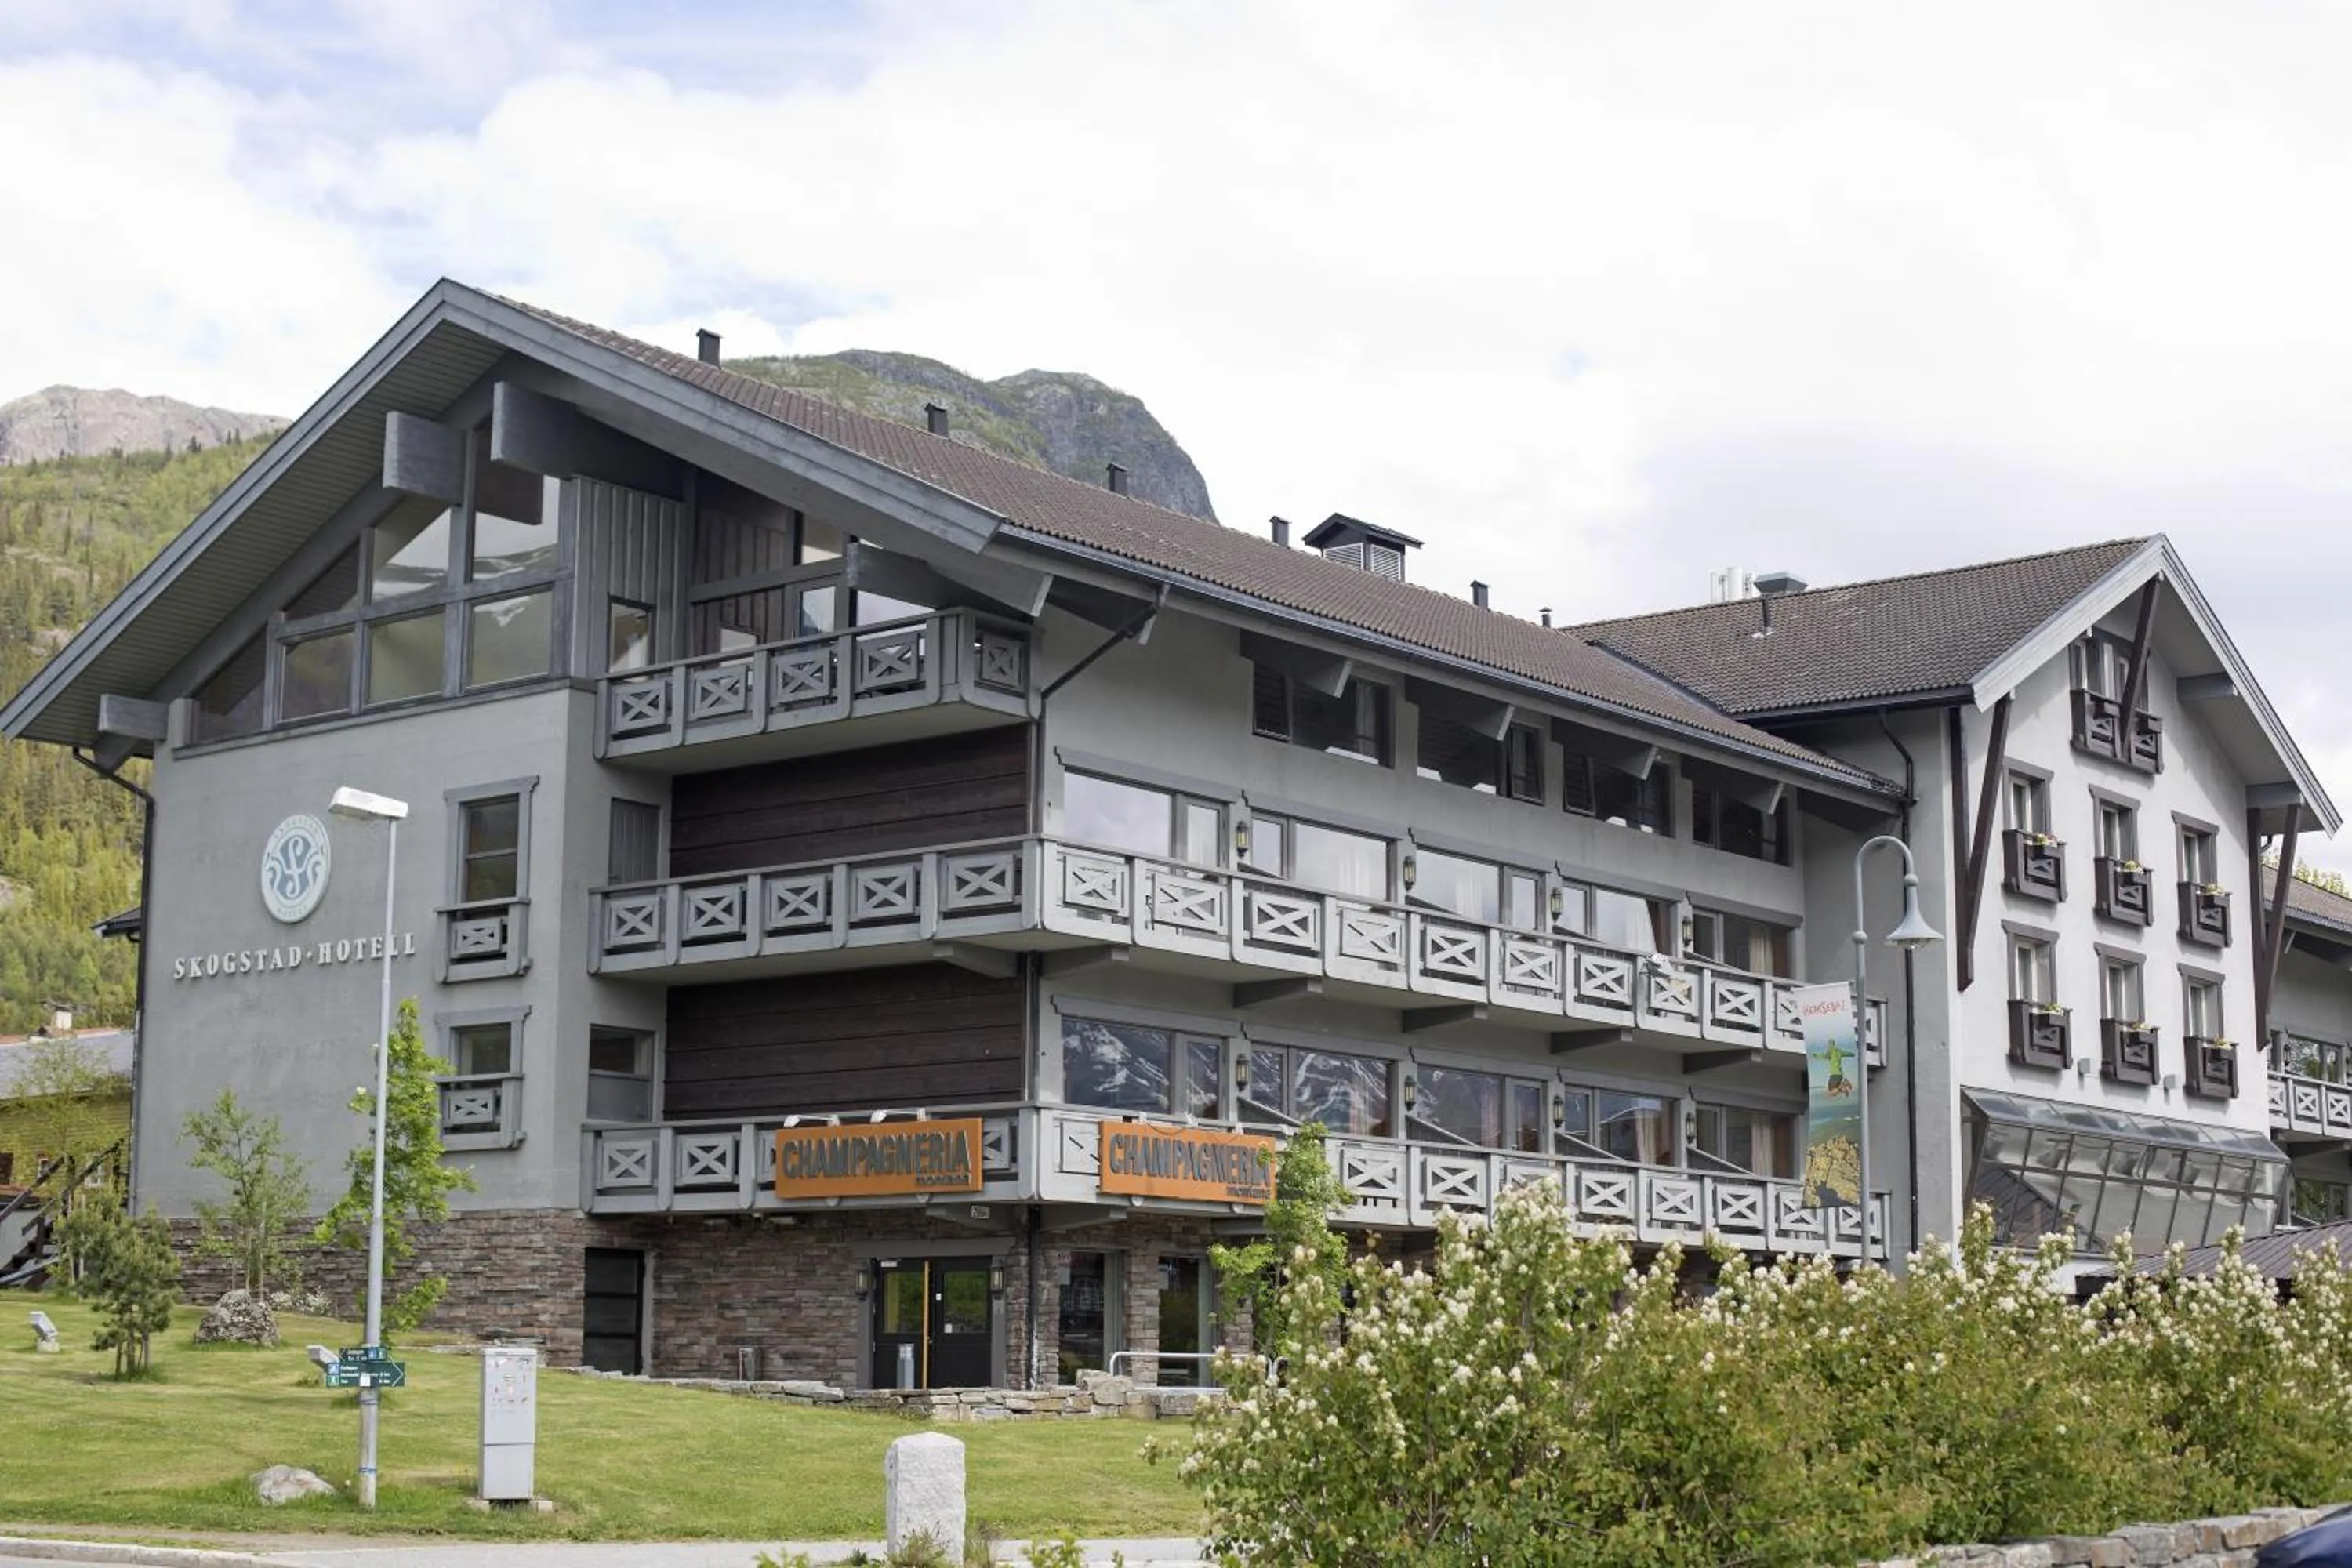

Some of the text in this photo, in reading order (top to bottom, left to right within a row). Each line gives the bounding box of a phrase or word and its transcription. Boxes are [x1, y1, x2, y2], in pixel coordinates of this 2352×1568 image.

[173, 932, 415, 979] SKOGSTAD HOTELL
[783, 1131, 971, 1178] CHAMPAGNERIA
